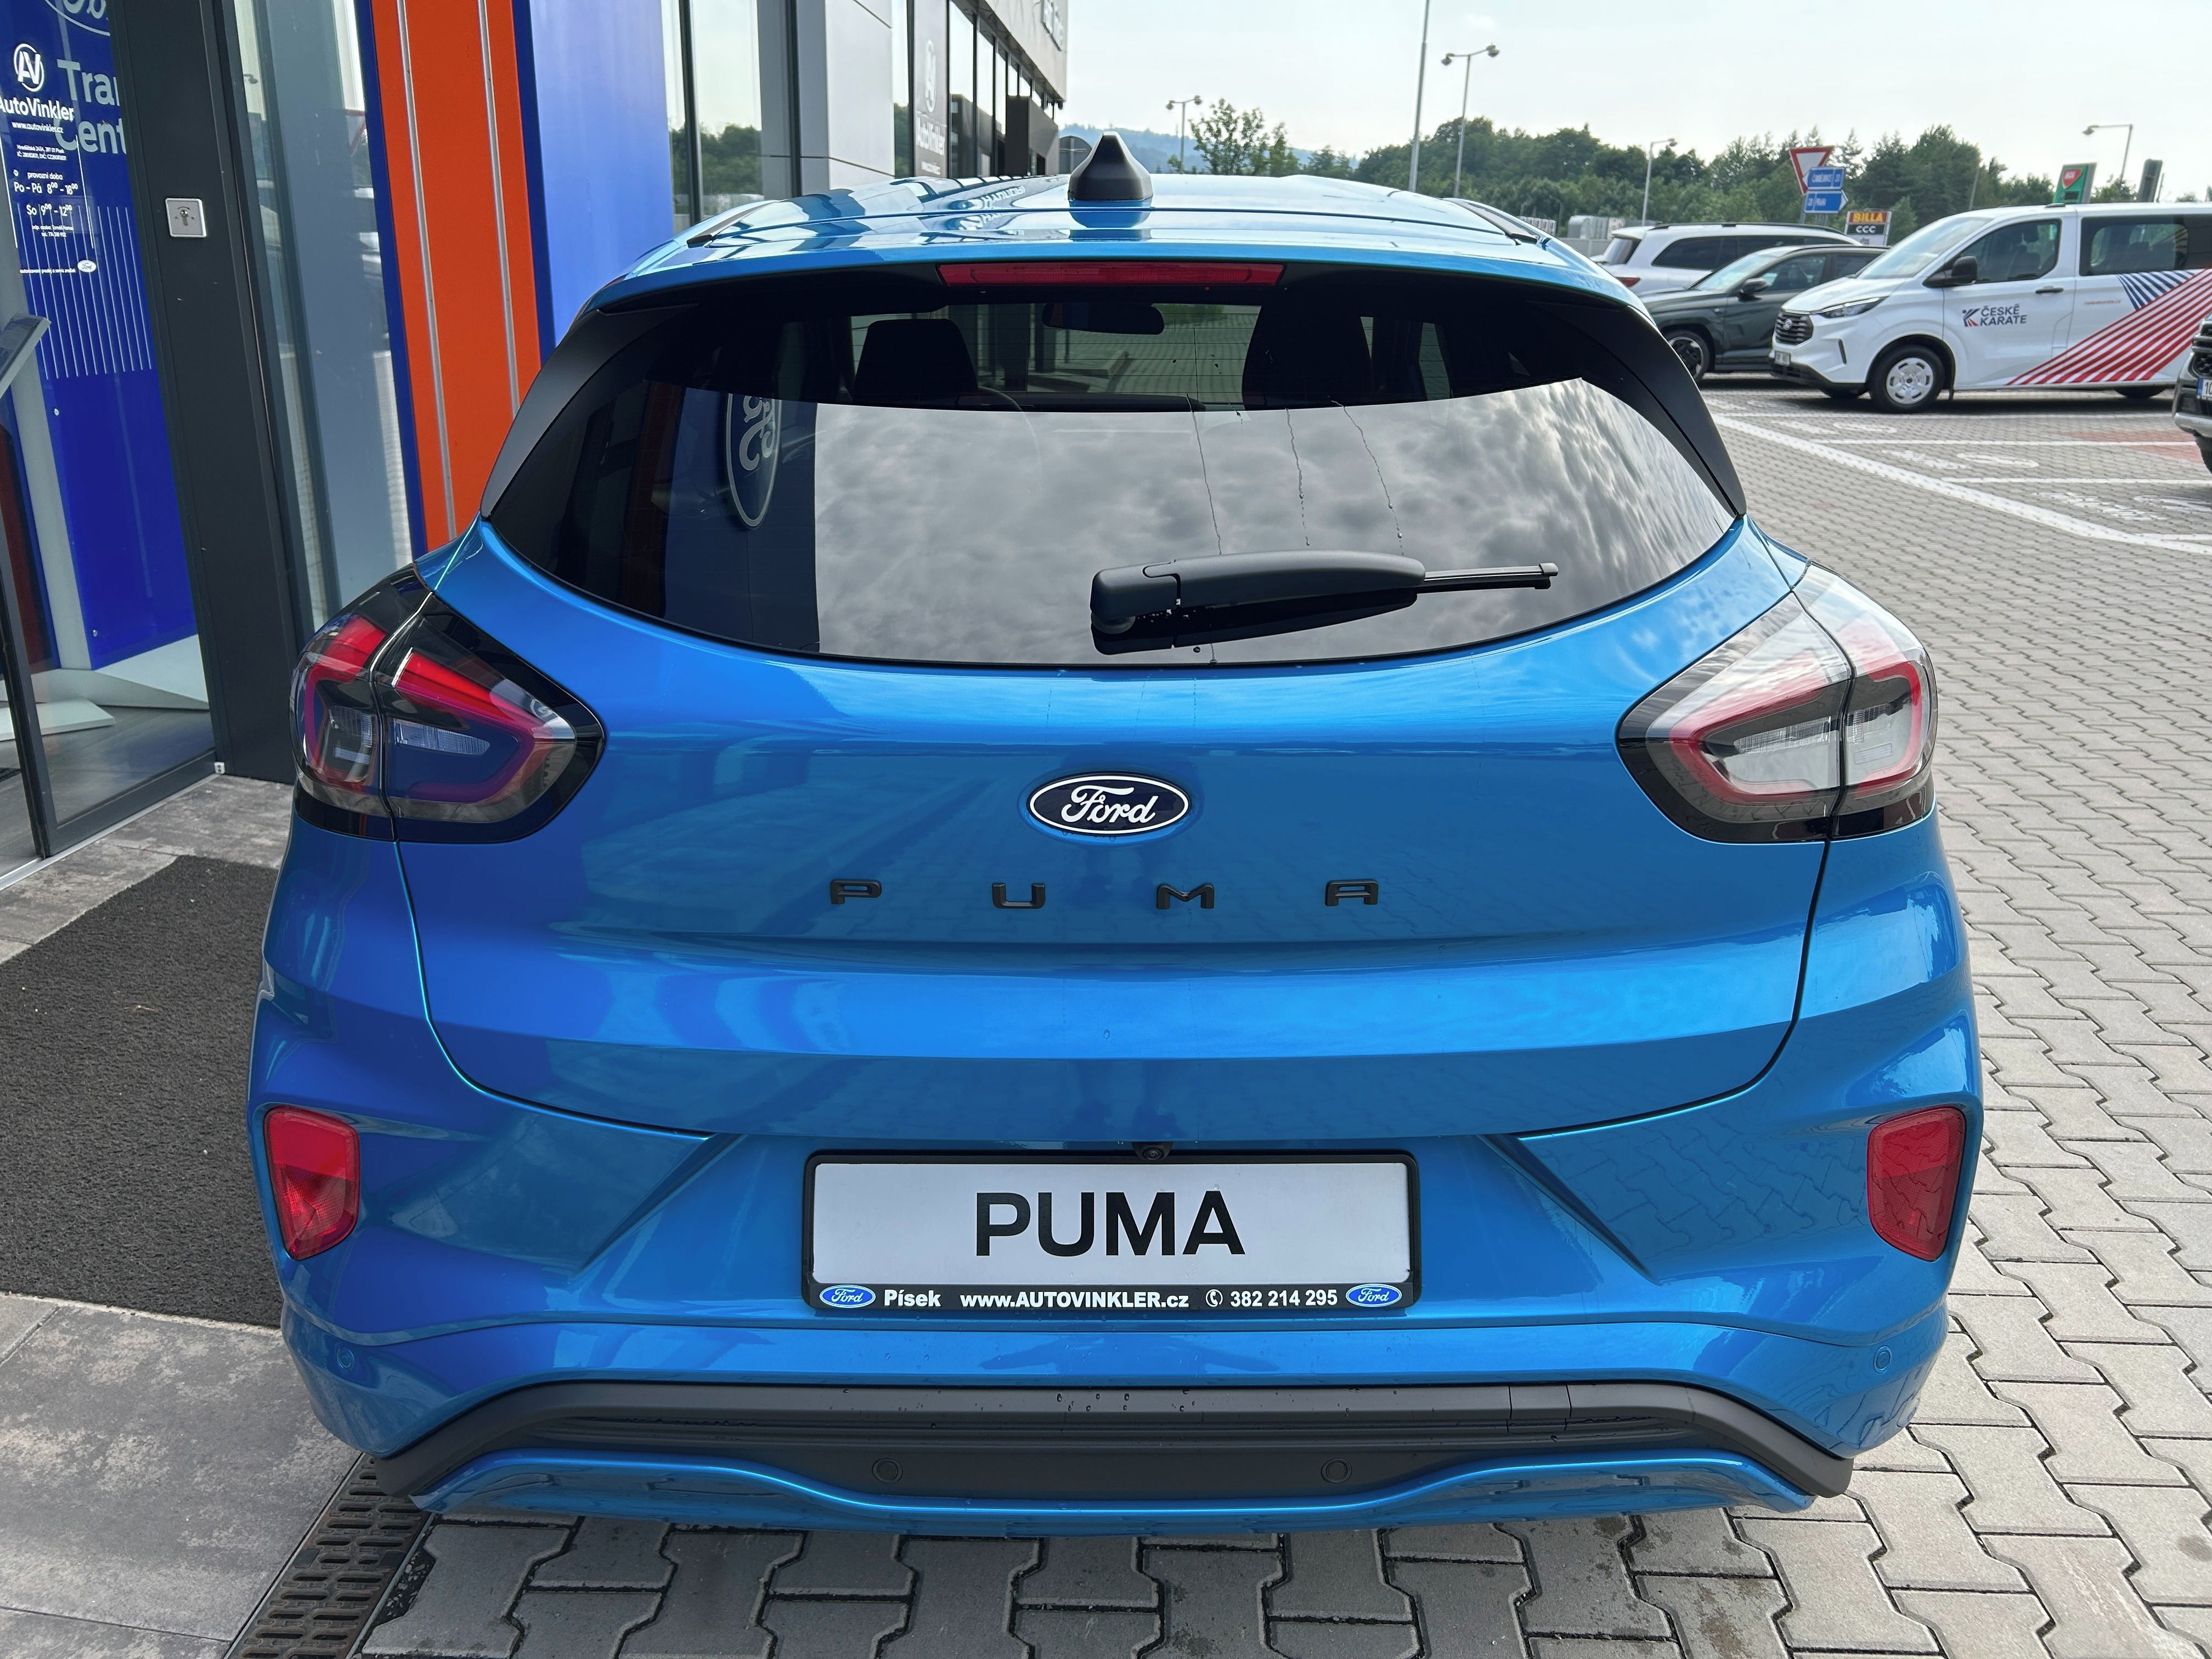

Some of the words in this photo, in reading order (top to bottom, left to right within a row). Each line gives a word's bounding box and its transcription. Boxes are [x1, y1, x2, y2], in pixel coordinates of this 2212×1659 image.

[0, 97, 74, 122] AutoVinkler
[14, 182, 25, 193] Po
[31, 182, 42, 194] Pá
[26, 204, 37, 216] So
[1852, 212, 1883, 222] BILLA
[1855, 225, 1876, 233] CCC
[1980, 303, 2020, 317] ČESKÉ
[1980, 314, 2027, 326] KARATE
[1061, 785, 1158, 823] Ford
[830, 879, 1379, 910] PUMA
[976, 1190, 1245, 1256] PUMA
[831, 1288, 864, 1302] Ford
[884, 1289, 941, 1307] Písek
[960, 1291, 1189, 1307] www.AUTOVINKLER.cz
[1230, 1290, 1262, 1307] 382
[1268, 1290, 1300, 1306] 214
[1305, 1289, 1338, 1306] 295
[1357, 1288, 1389, 1302] Ford
